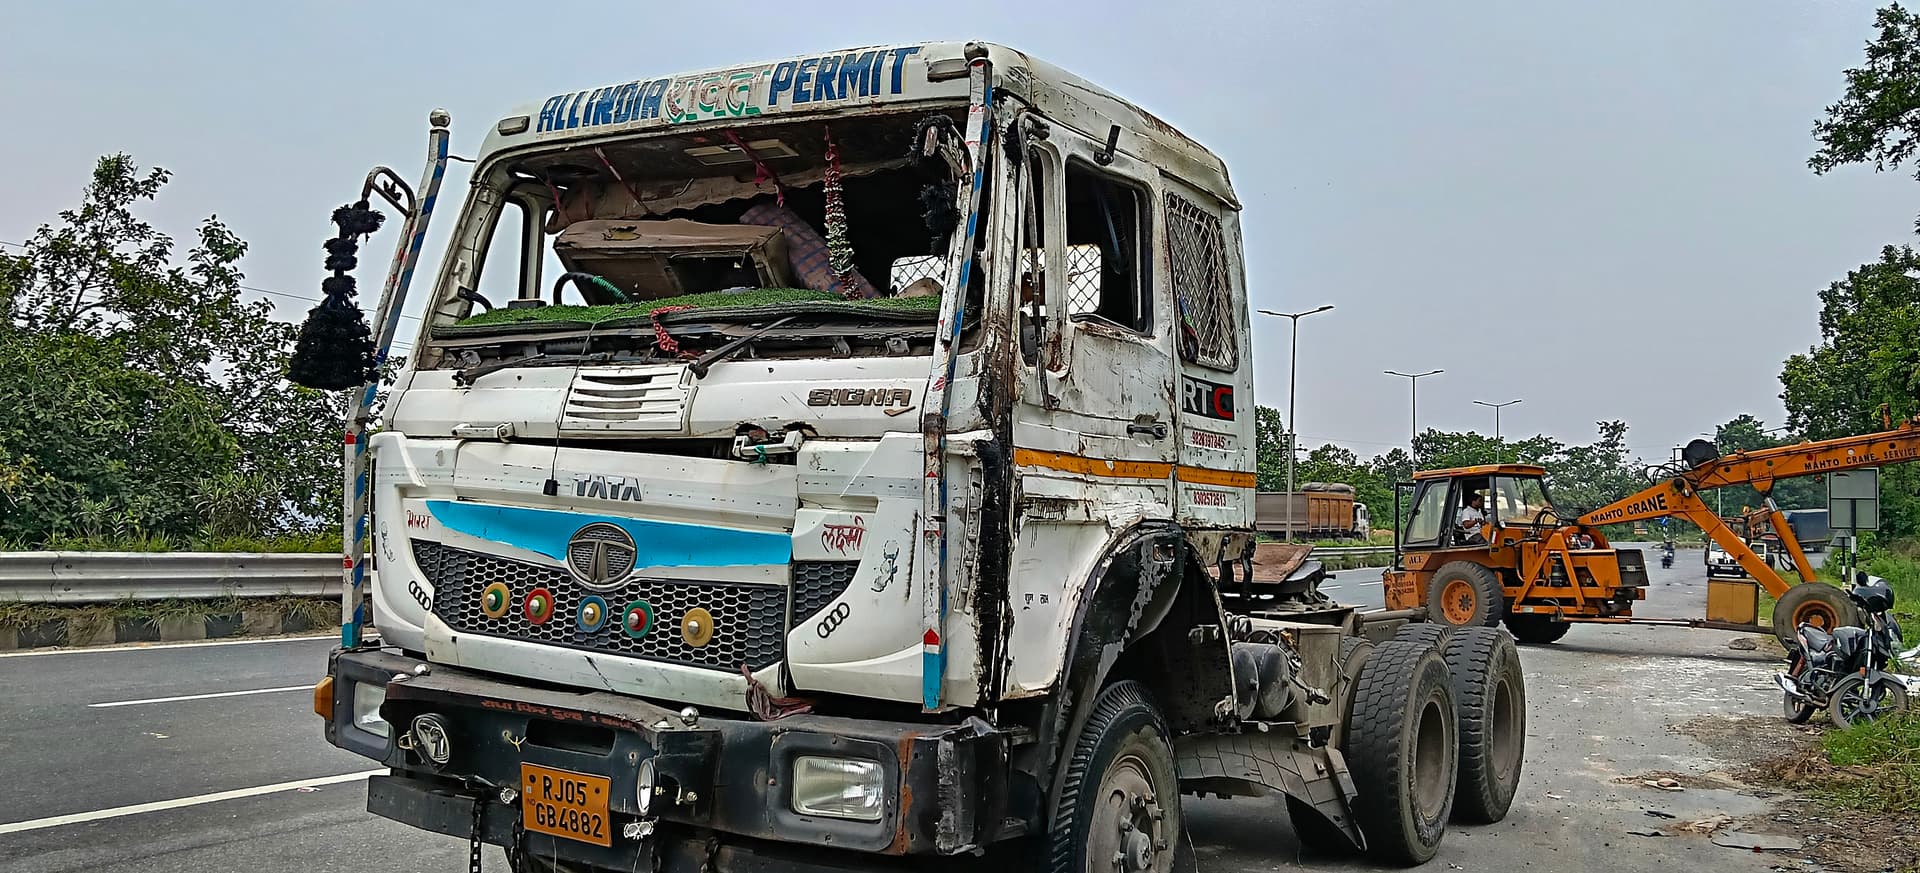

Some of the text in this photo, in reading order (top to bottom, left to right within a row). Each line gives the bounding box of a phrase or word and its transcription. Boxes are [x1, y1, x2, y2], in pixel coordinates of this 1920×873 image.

[769, 46, 921, 105] PERMIT
[537, 79, 669, 132] ALL INDIA
[808, 388, 912, 406] SIGNA
[1182, 378, 1233, 418] RTC
[1804, 447, 1917, 470] MAHTO CRANE SERVICE
[573, 474, 642, 501] TATA
[1590, 493, 1668, 523] MAHTO CRANE
[542, 775, 588, 807] RJ05
[535, 802, 603, 839] GB4882
